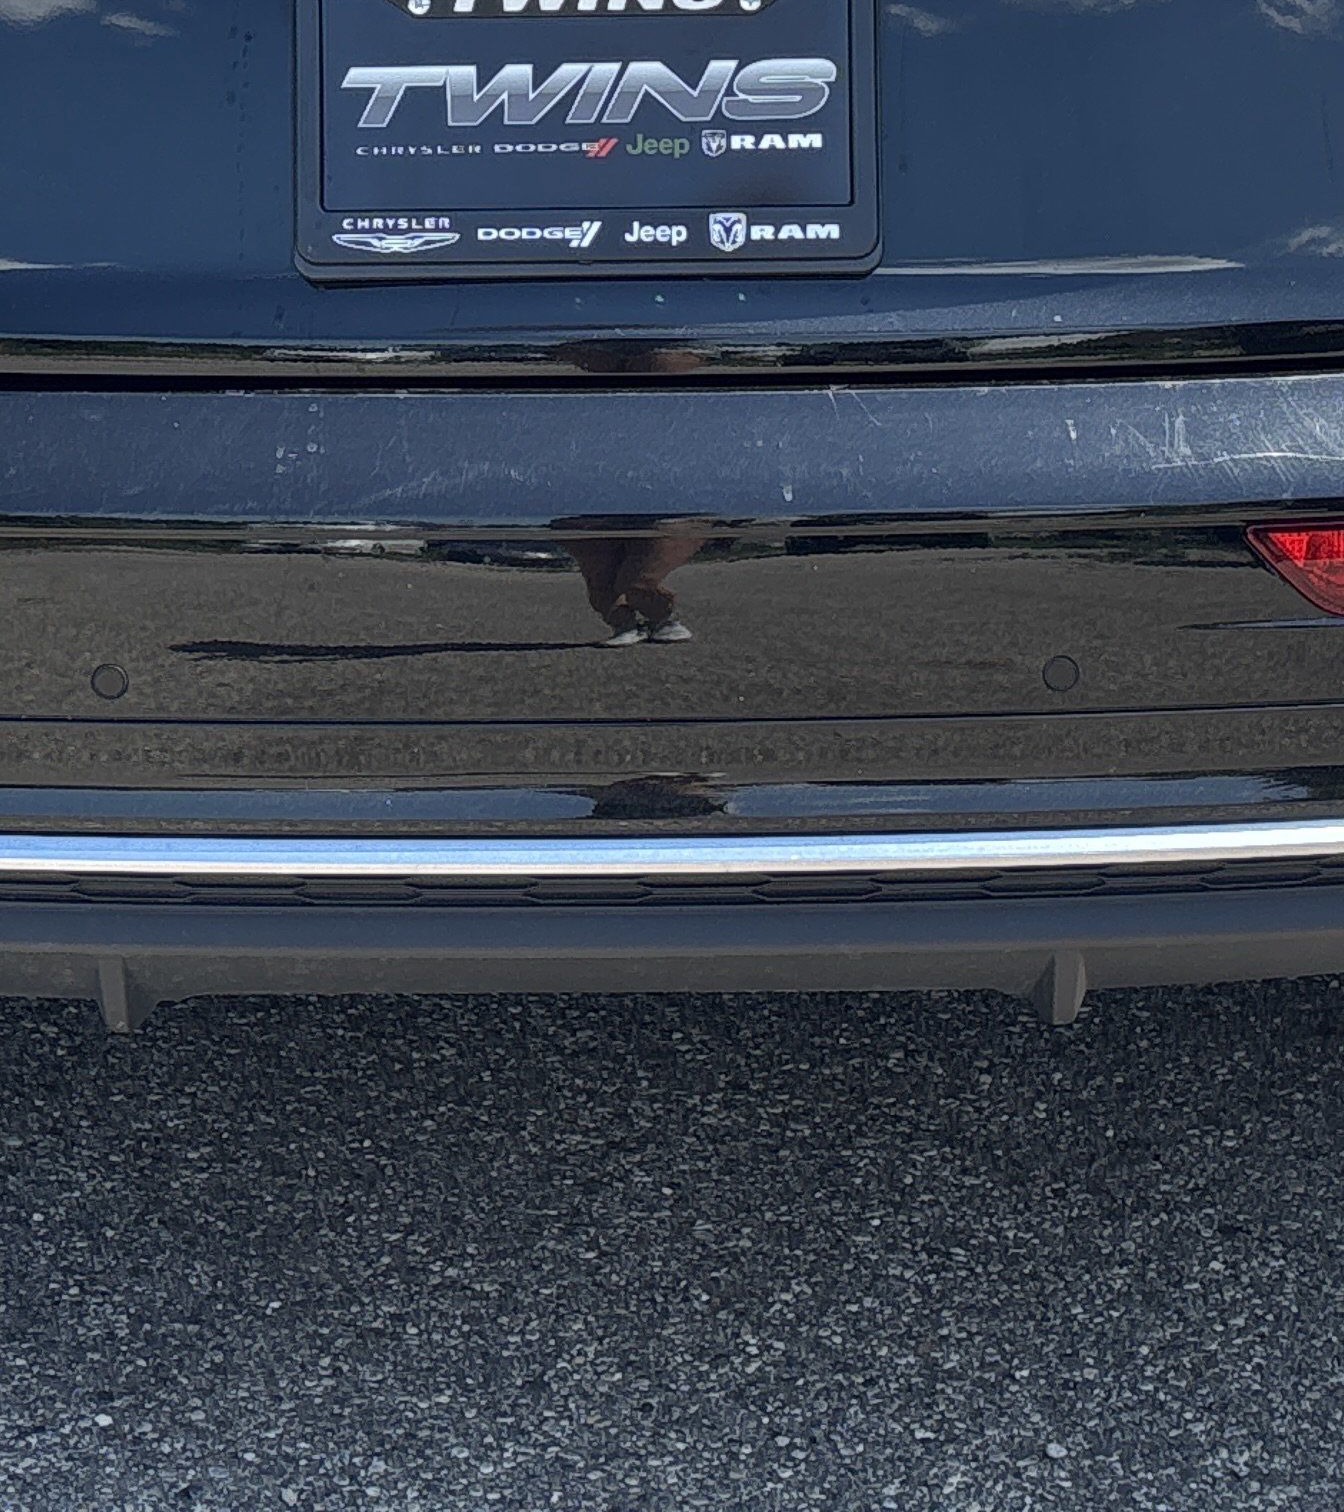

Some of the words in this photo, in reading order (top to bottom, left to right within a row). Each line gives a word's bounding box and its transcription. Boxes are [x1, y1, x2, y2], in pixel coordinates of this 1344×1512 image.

[340, 57, 838, 127] TWINS
[355, 144, 483, 156] CHRYSLER
[493, 141, 600, 154] DODGE
[625, 133, 691, 159] Jeep
[729, 132, 823, 150] RAM
[341, 216, 451, 230] CHRYSLER
[476, 226, 583, 241] DODGE
[624, 220, 688, 246] Jeep
[749, 222, 841, 241] RAM
